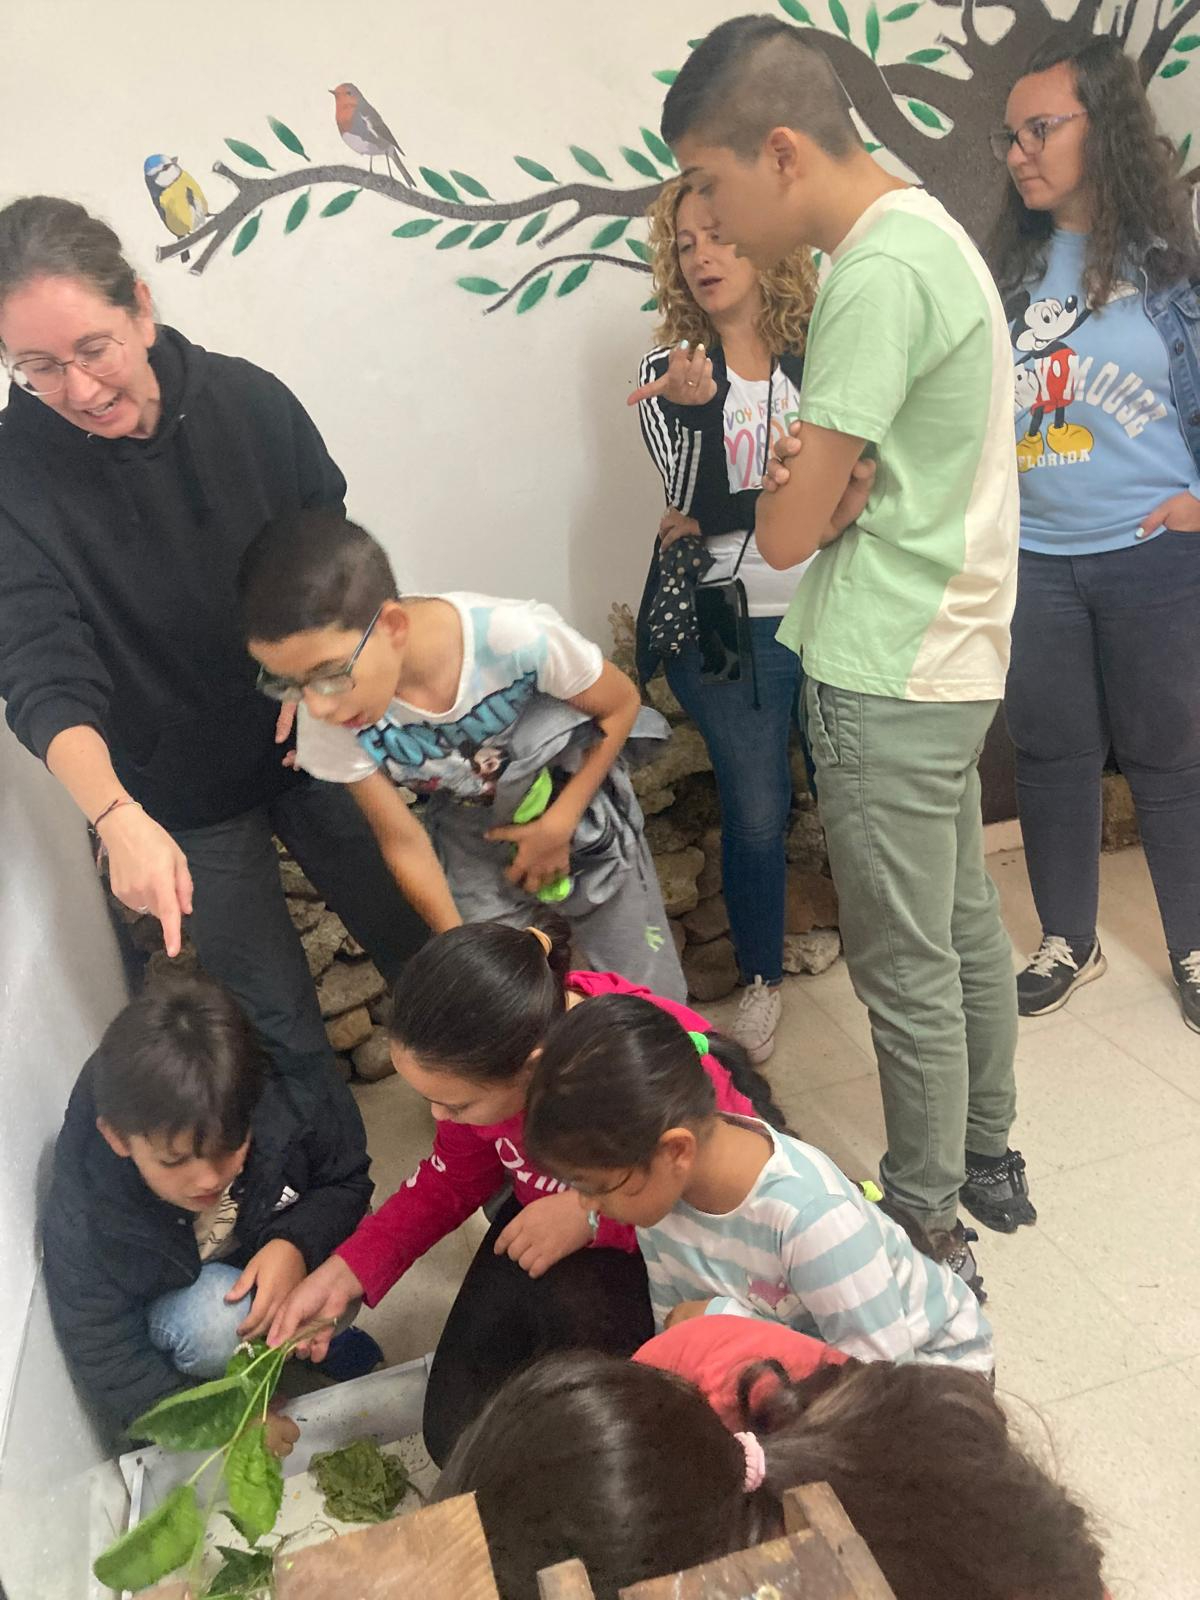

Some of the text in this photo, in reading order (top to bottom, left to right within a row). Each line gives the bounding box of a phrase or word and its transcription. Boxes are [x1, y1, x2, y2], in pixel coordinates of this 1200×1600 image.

[1063, 355, 1167, 438] MOUSE
[723, 407, 753, 431] VOY
[1017, 449, 1090, 468] FLORIDA
